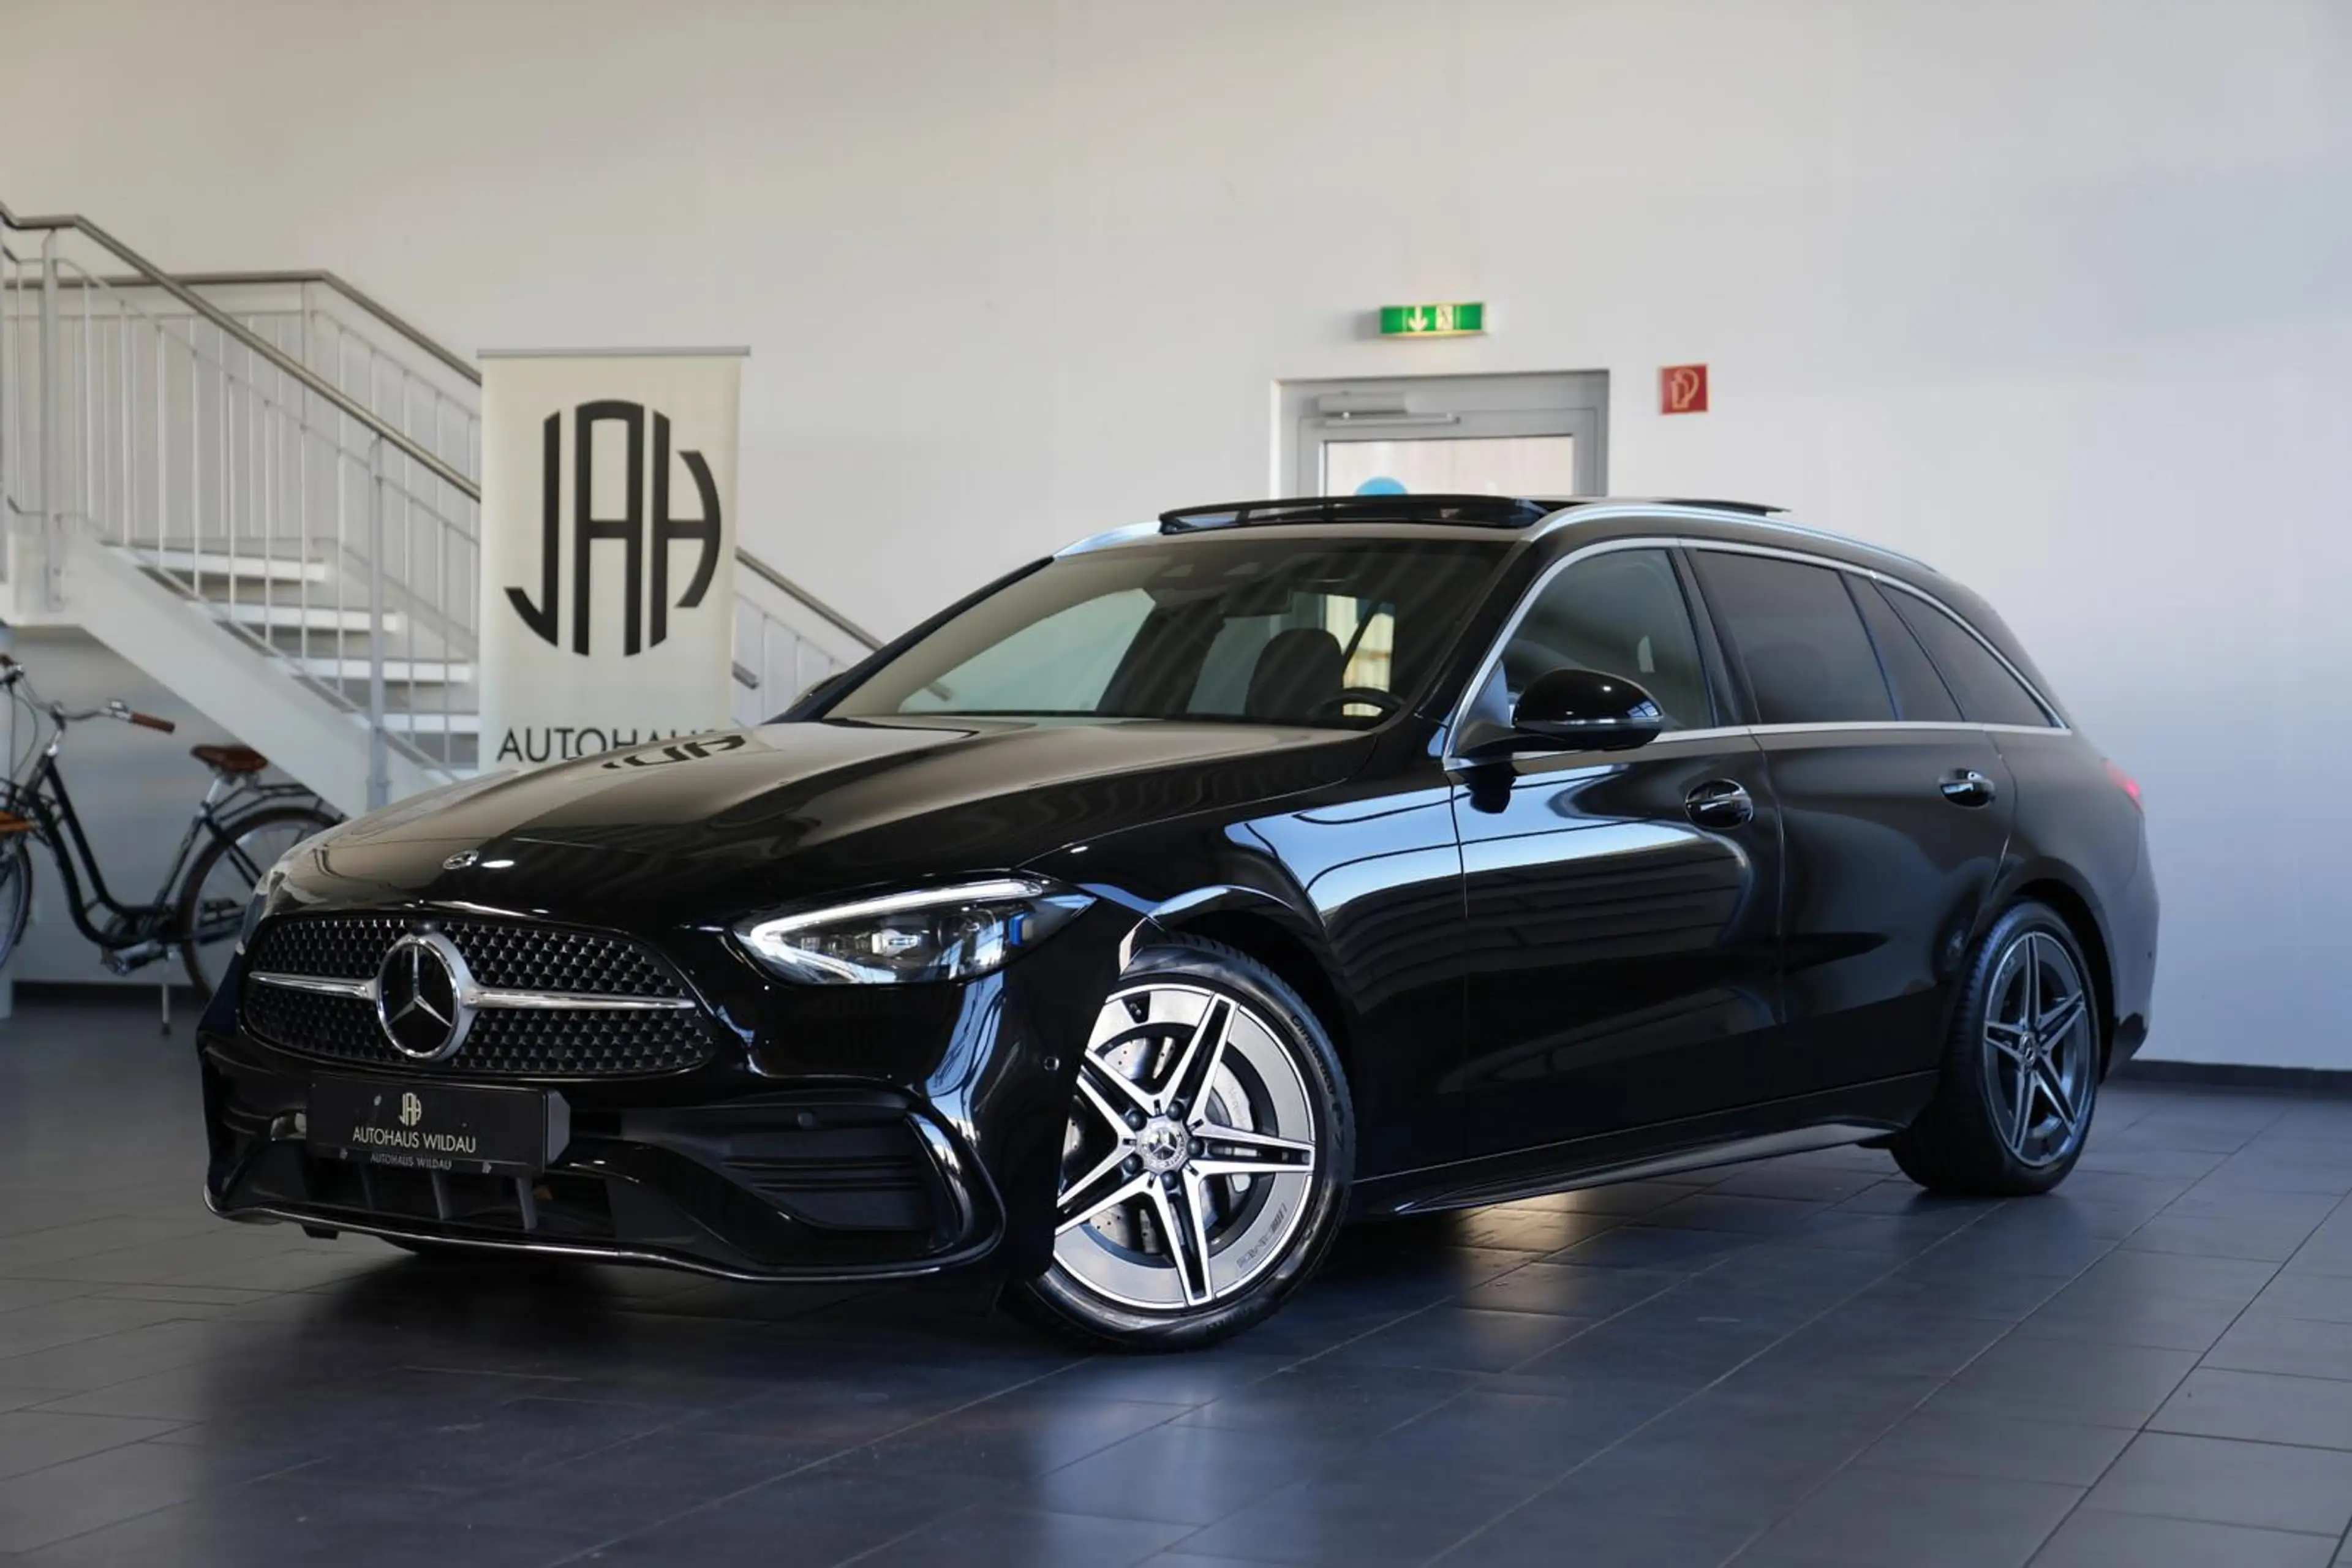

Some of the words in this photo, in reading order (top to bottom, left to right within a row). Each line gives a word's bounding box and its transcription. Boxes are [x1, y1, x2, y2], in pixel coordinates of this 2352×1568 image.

[497, 727, 715, 763] AUTOH
[352, 1126, 420, 1148] AUTOHAUS
[423, 1133, 477, 1153] WILDAU
[371, 1152, 414, 1167] AUTOHAUS
[417, 1157, 453, 1170] WILDAU
